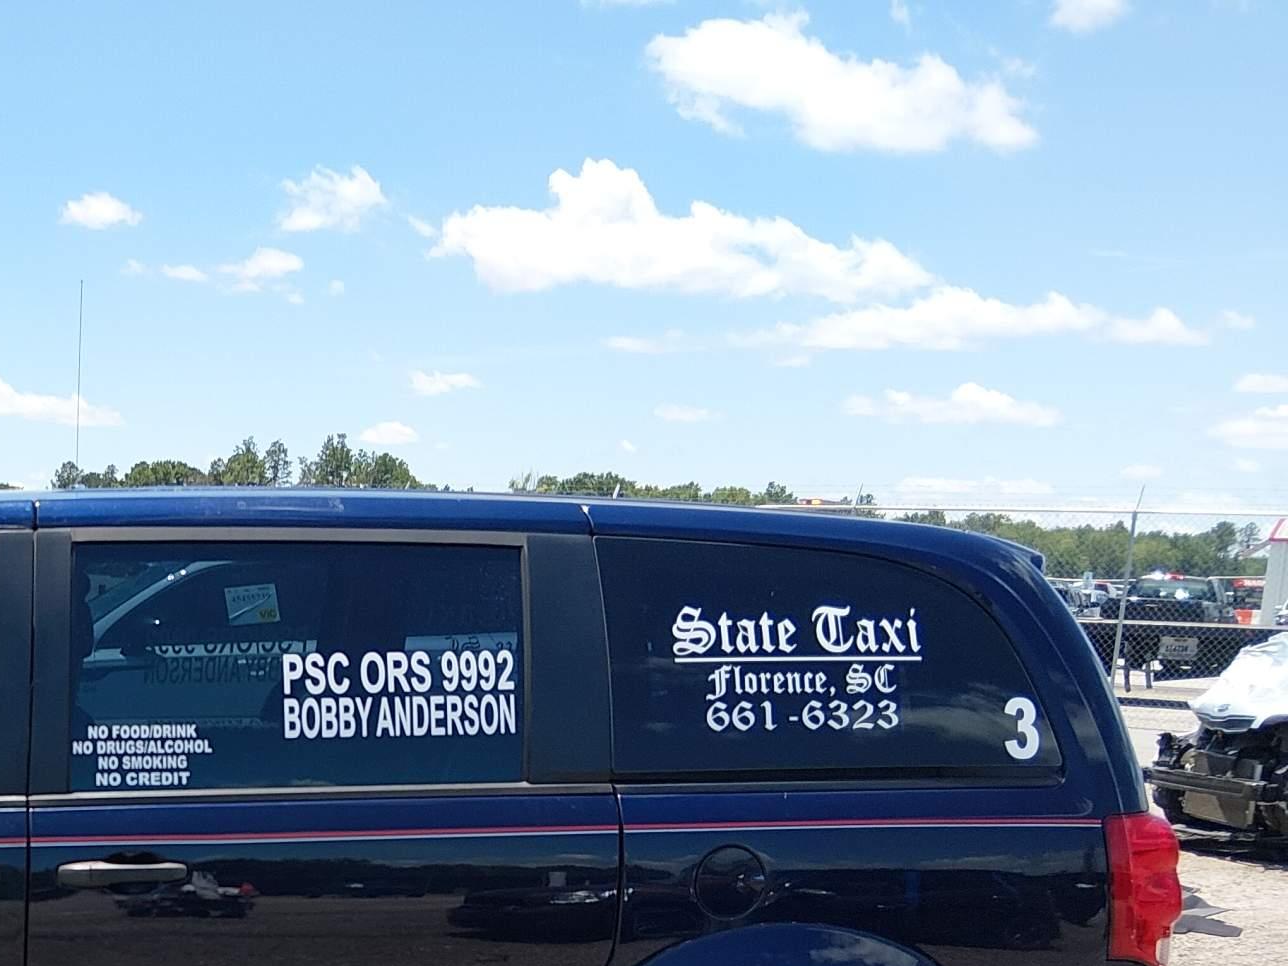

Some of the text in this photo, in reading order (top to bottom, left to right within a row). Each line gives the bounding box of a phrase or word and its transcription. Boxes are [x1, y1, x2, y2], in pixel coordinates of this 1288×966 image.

[672, 606, 921, 655] State Taxi
[283, 652, 350, 695] PSC
[360, 651, 432, 694] ORS
[440, 650, 515, 692] 9992
[705, 664, 897, 700] Florence, SC
[87, 724, 197, 739] NO FOOD/DRINK
[284, 693, 516, 738] BOBBY ANDERSON
[1003, 697, 1039, 760] 3
[72, 739, 212, 754] NO DRUGS/ALCOHOL
[98, 755, 188, 770] NO SMOKING
[96, 771, 190, 786] NO CREDIT
